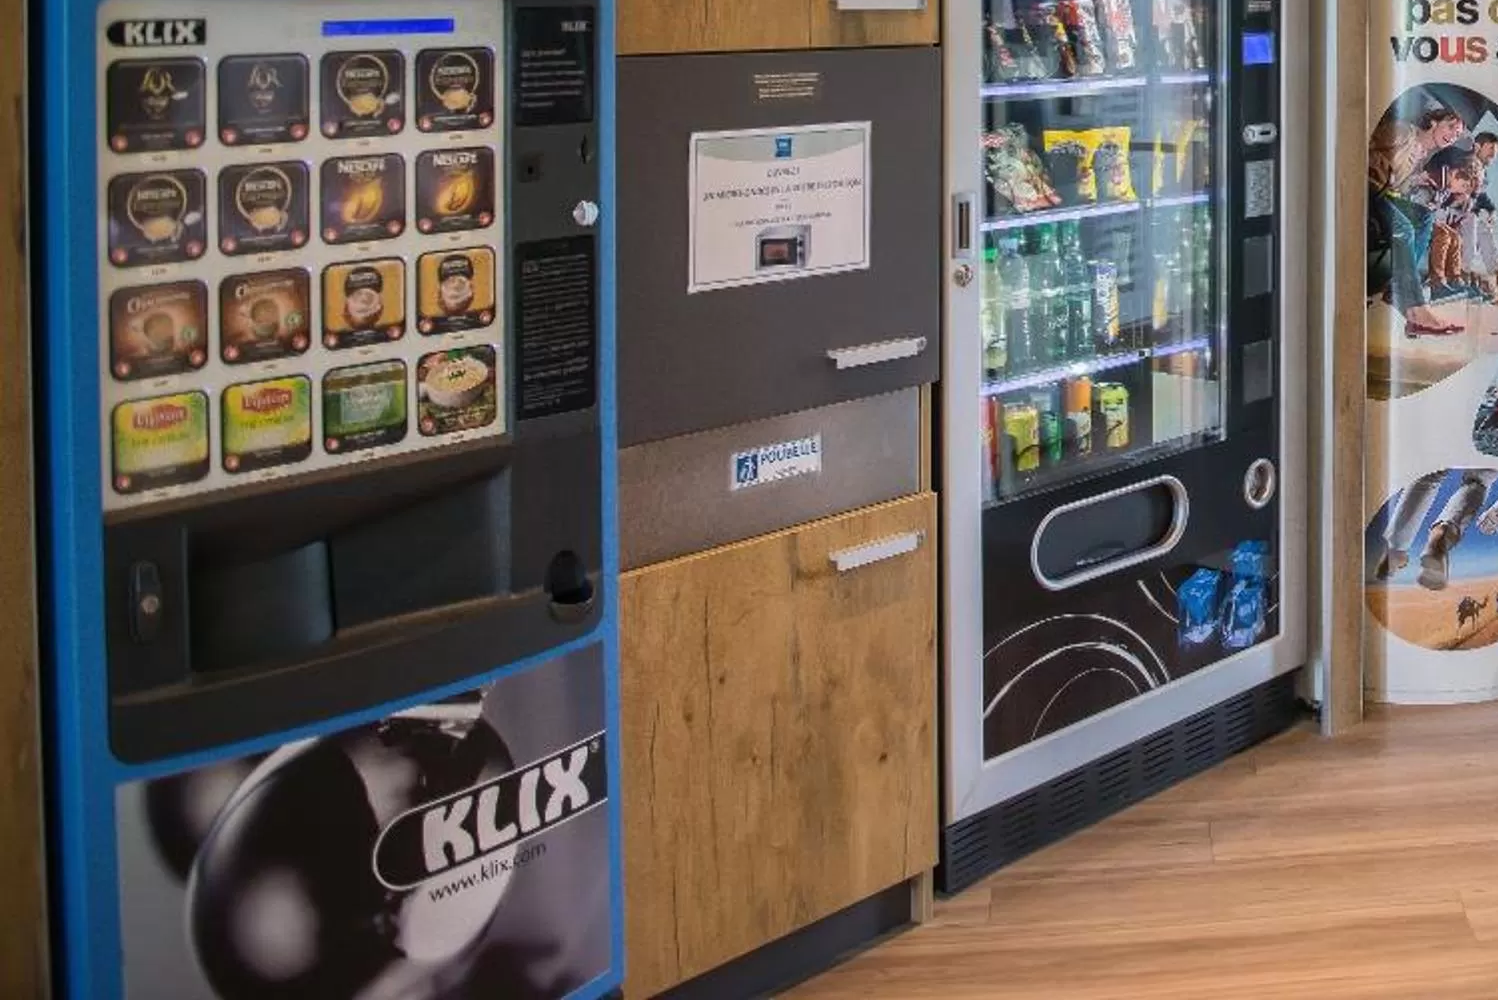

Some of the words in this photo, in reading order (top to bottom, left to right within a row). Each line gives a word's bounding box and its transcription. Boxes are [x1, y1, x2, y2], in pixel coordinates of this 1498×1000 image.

[123, 20, 200, 46] KLIX
[1390, 35, 1488, 64] vous
[422, 745, 590, 873] KLIX
[429, 842, 547, 903] www.klix.com
